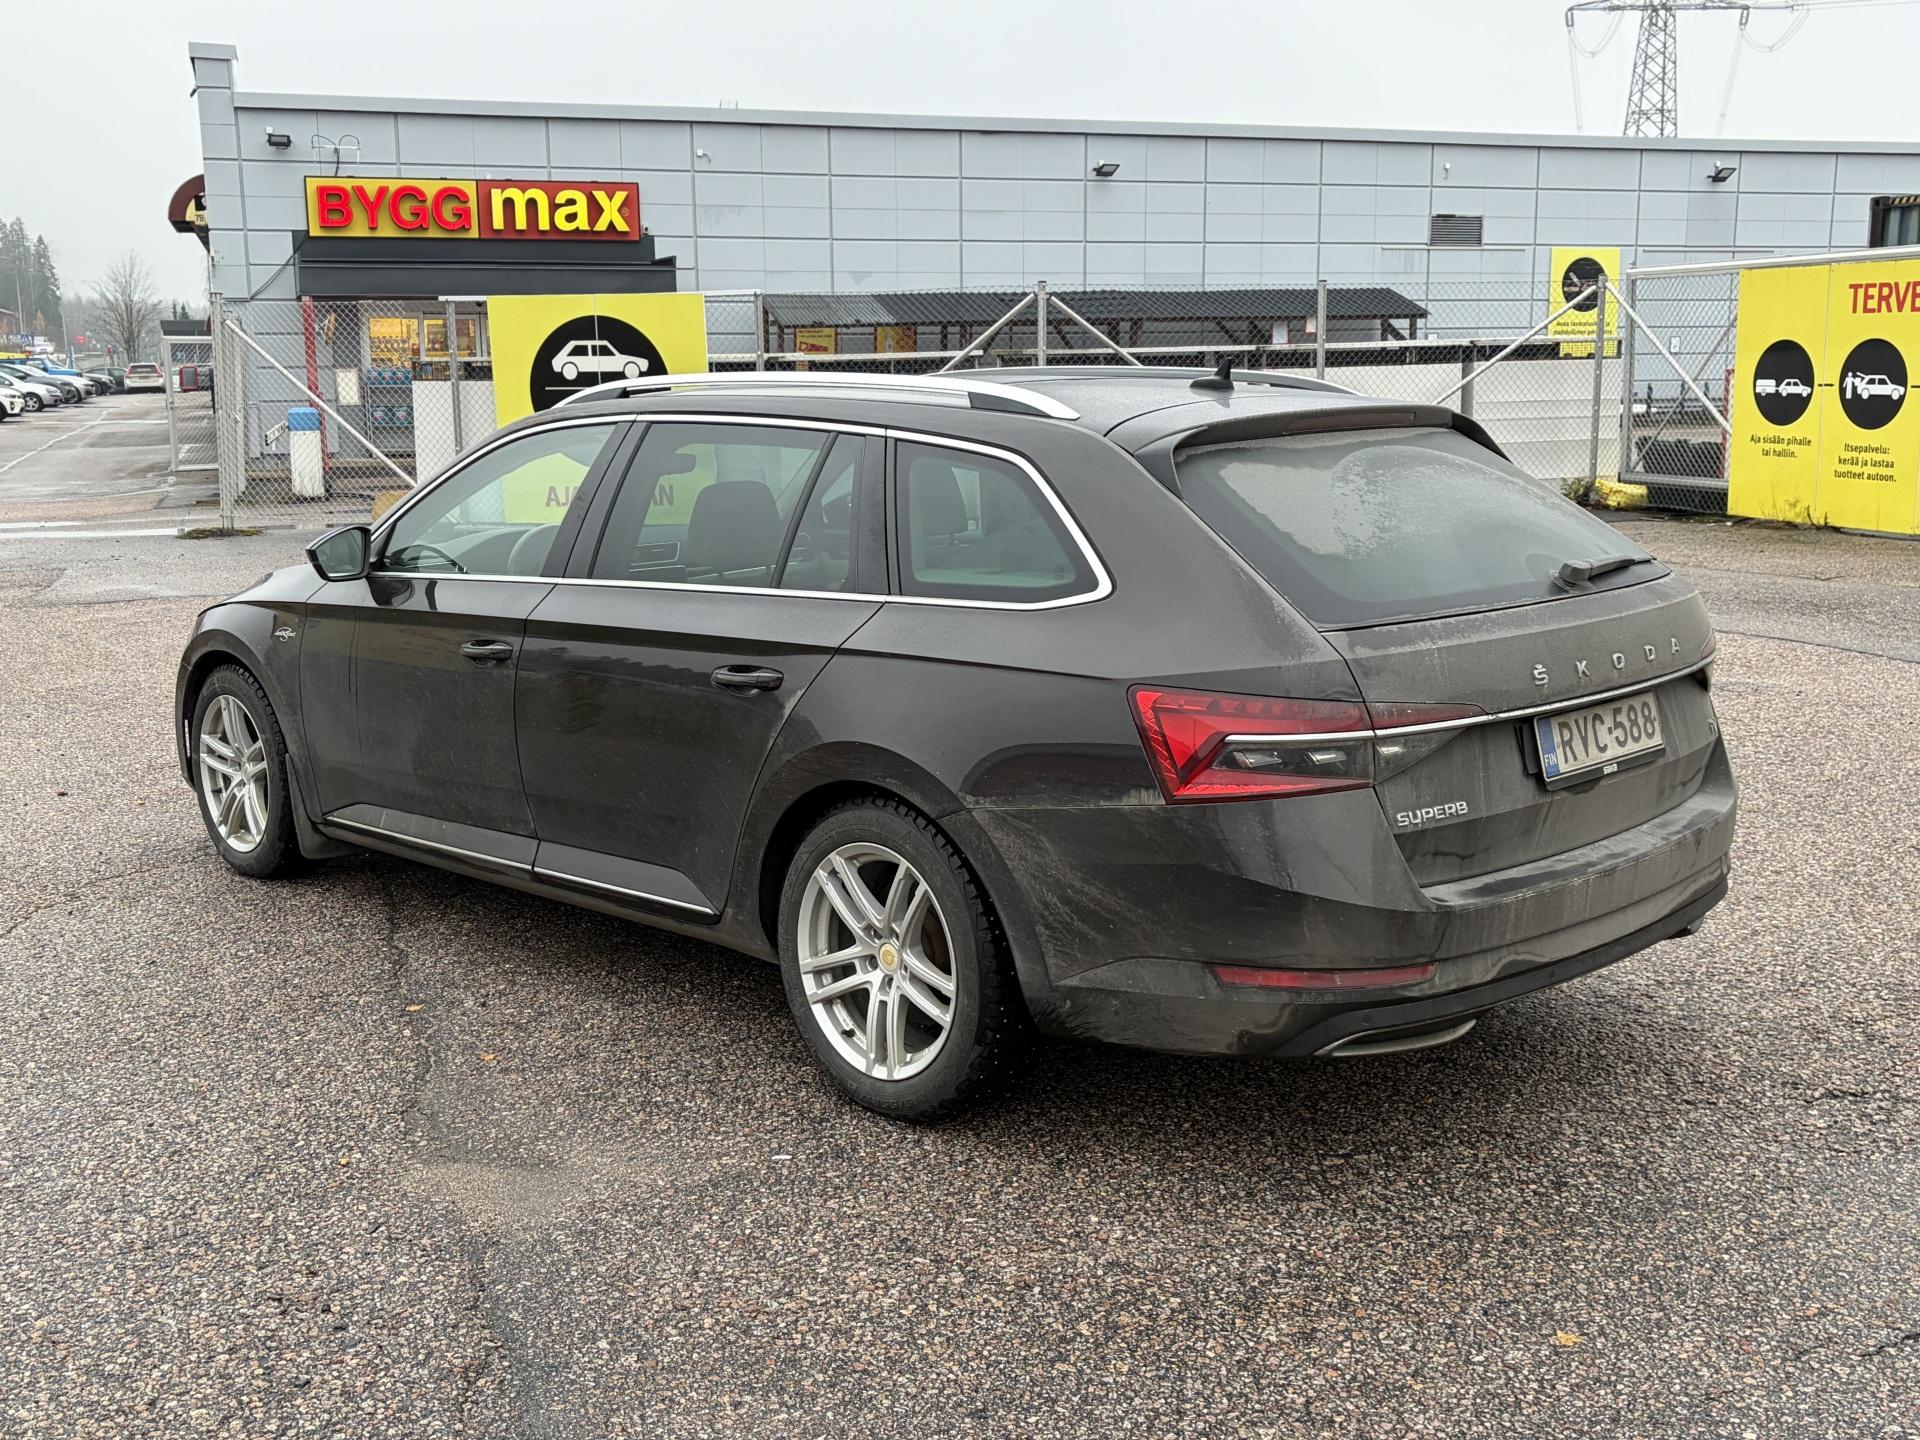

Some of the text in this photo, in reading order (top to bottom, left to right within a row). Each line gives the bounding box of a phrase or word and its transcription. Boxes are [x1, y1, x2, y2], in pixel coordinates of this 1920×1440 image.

[316, 184, 630, 233] BYGG max
[1849, 281, 1920, 314] TERVE
[1750, 433, 1812, 447] Aja sisään pihalle
[1844, 442, 1890, 455] Itsepalvelu:
[1762, 448, 1797, 459] tai halliin.
[1838, 455, 1895, 469] kerää ja lastaa
[1834, 469, 1897, 483] tuotteet autoon.
[1533, 637, 1680, 686] ŠKODA
[1544, 700, 1656, 767] FIN RVC-588
[1396, 800, 1469, 827] SUPERB
